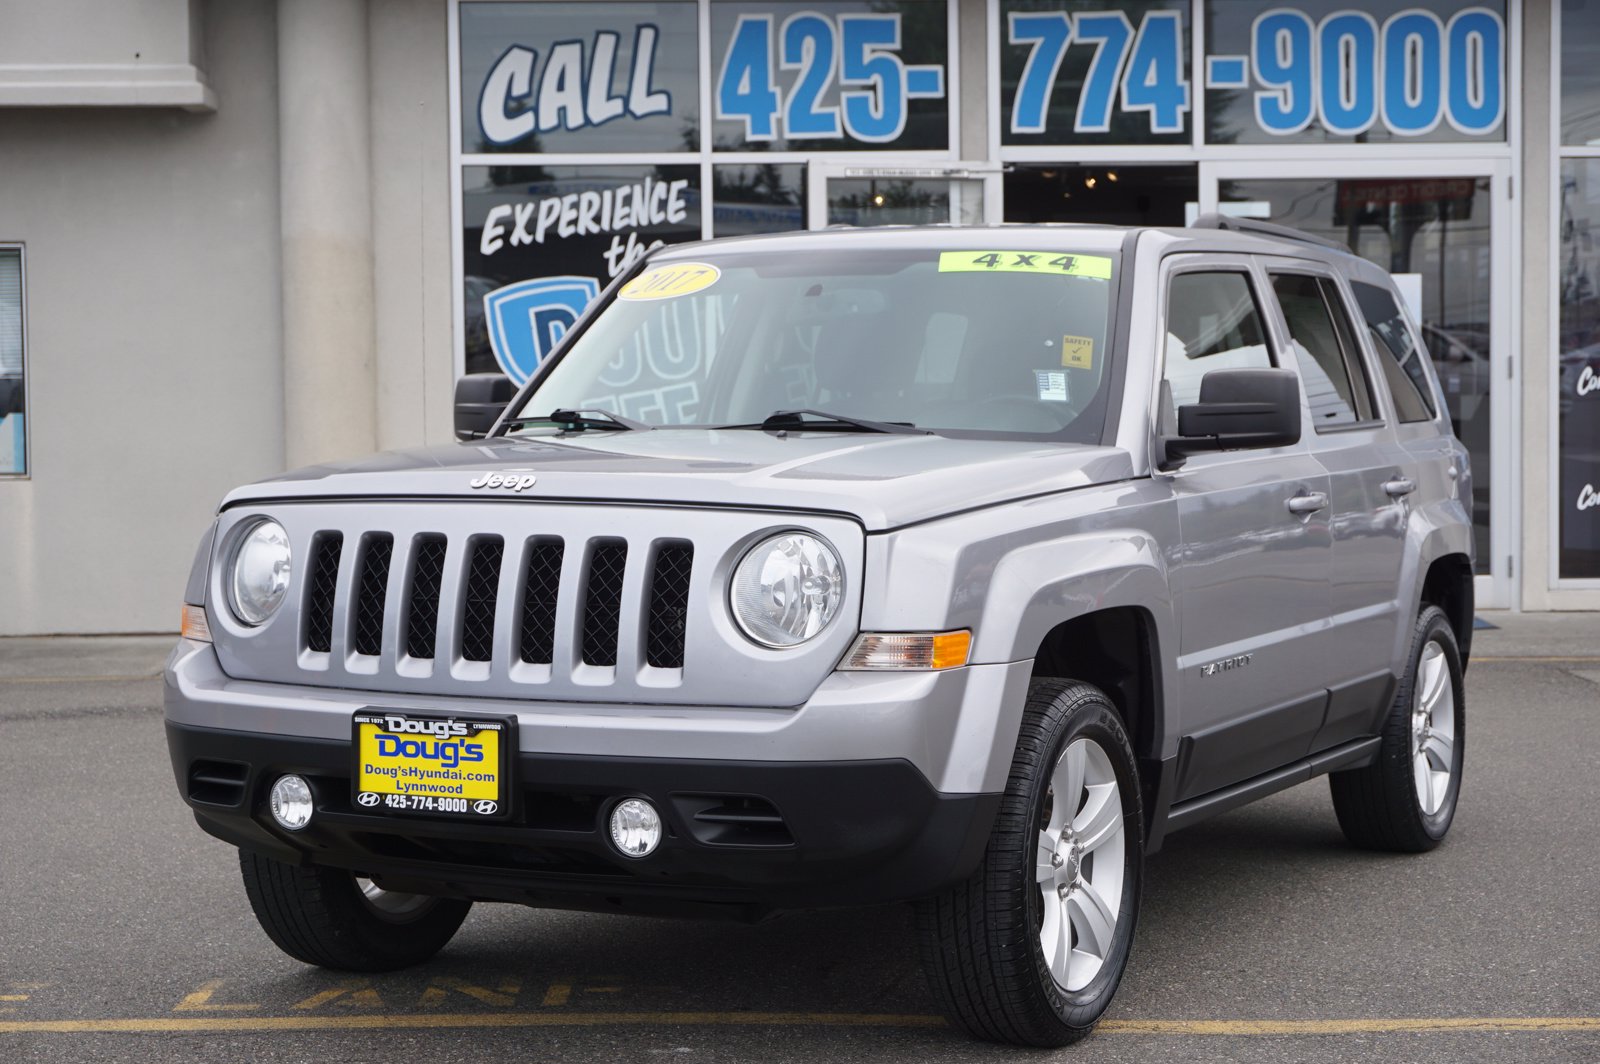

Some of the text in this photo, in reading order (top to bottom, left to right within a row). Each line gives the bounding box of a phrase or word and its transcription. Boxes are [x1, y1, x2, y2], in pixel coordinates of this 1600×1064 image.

[479, 23, 671, 145] CALL
[716, 11, 945, 143] 425-
[480, 177, 689, 256] EXPERIENCE
[628, 269, 710, 295] 2017
[1064, 336, 1091, 346] SAFETY
[470, 471, 536, 492] Jeep
[1200, 653, 1253, 678] PATRIOT
[385, 716, 468, 740] Doug's
[374, 734, 484, 768] Doug's
[365, 764, 495, 782] Doug'sHyundai.com
[396, 780, 463, 794] Lynnwood
[385, 794, 467, 812] 425-774-9000
